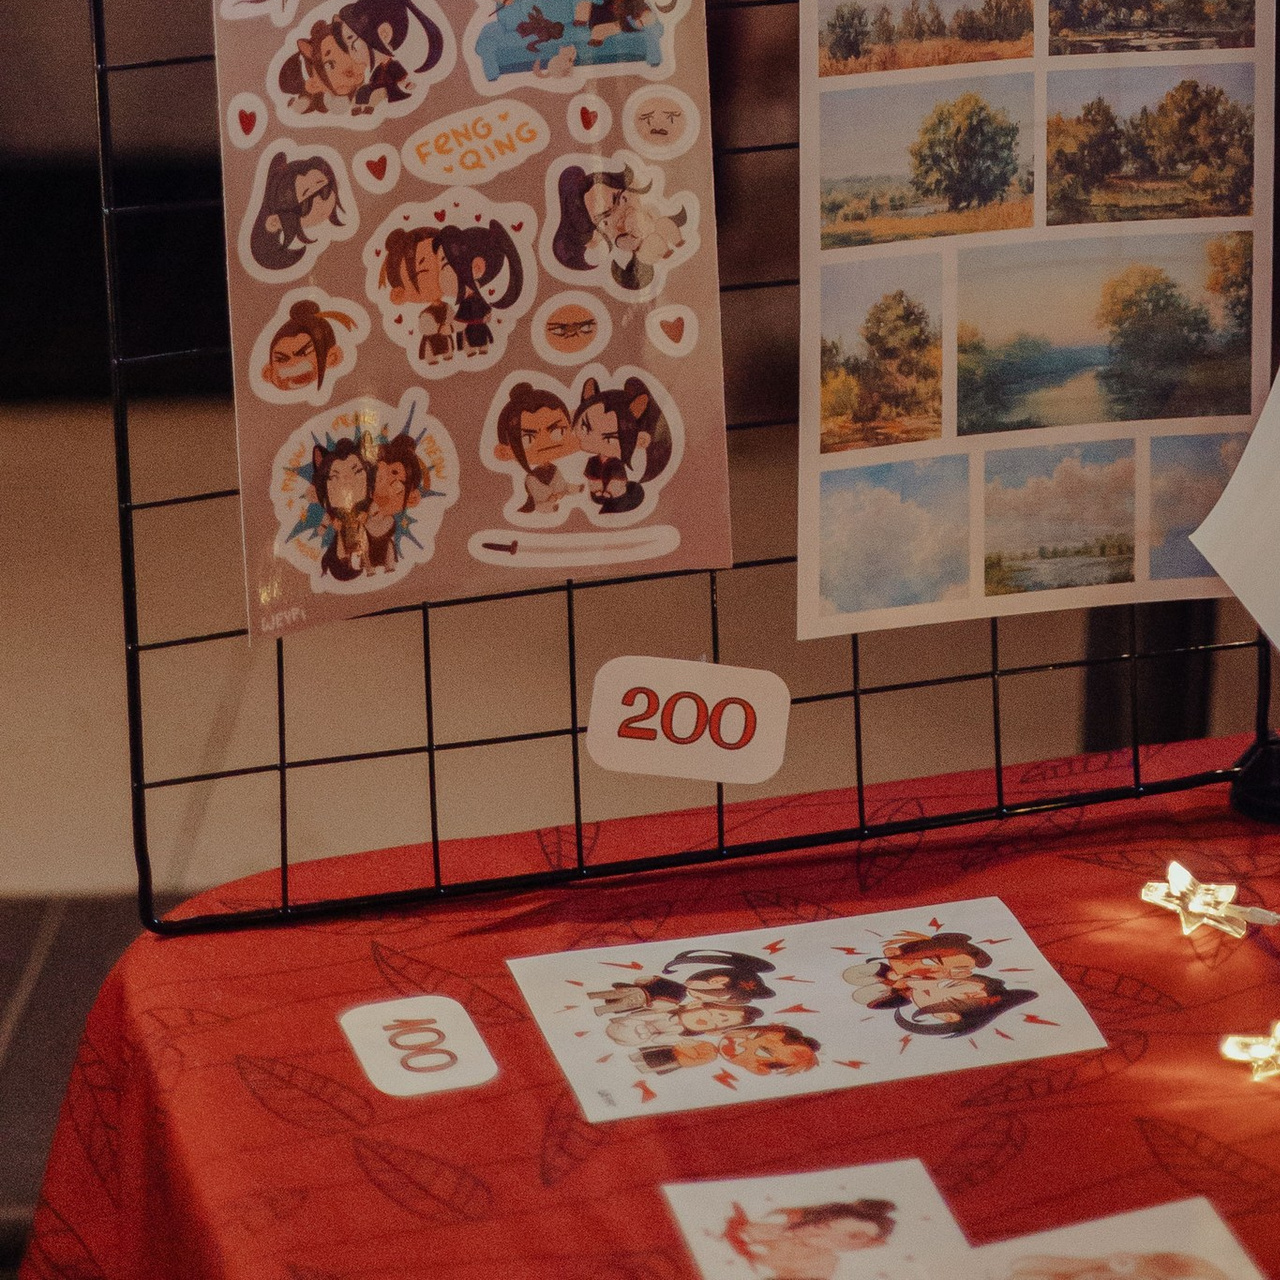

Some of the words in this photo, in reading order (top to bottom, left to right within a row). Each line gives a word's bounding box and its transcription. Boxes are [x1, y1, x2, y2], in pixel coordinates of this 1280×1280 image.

[458, 120, 538, 171] QING
[617, 686, 757, 750] 200
[382, 1018, 459, 1074] 100
